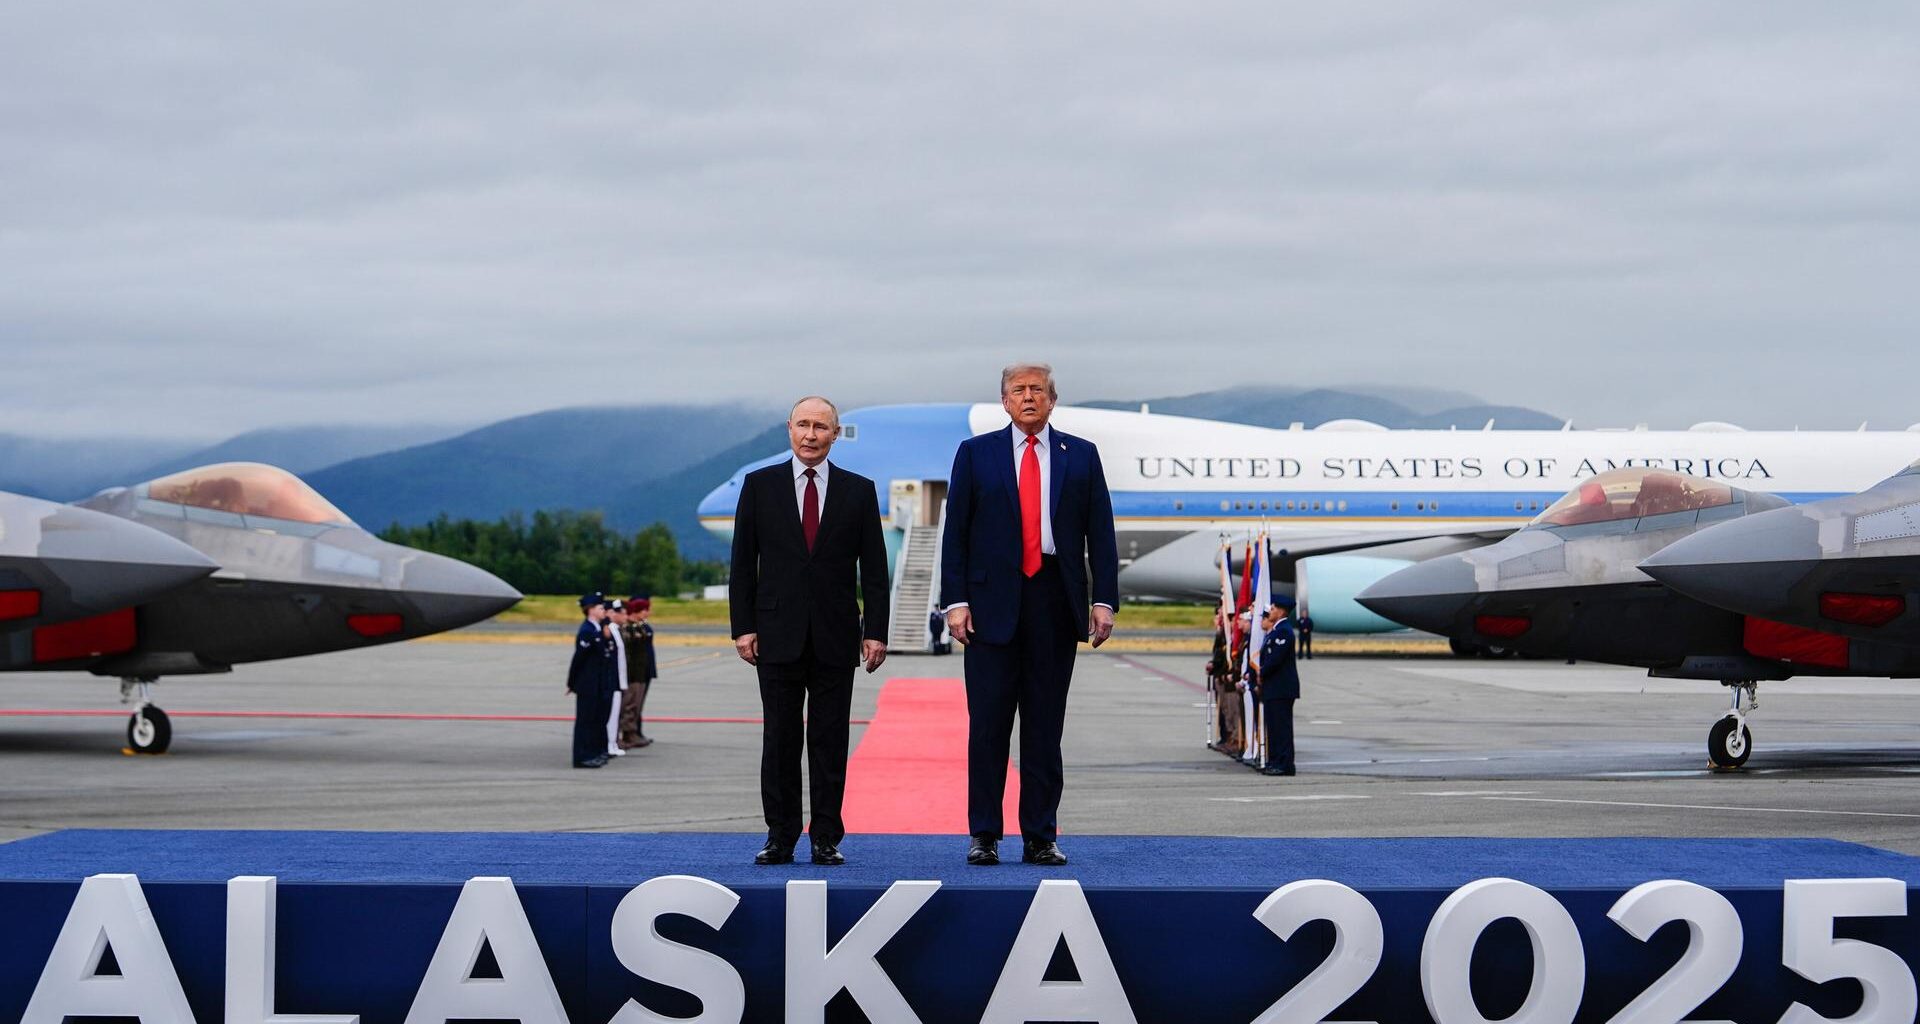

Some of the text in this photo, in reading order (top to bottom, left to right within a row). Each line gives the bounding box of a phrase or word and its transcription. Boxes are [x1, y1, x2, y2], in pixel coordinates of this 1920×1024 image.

[1136, 457, 1301, 479] UNITED
[1322, 457, 1483, 479] STATES
[1503, 457, 1557, 479] OF
[19, 873, 1919, 1024] ALASKA 2025
